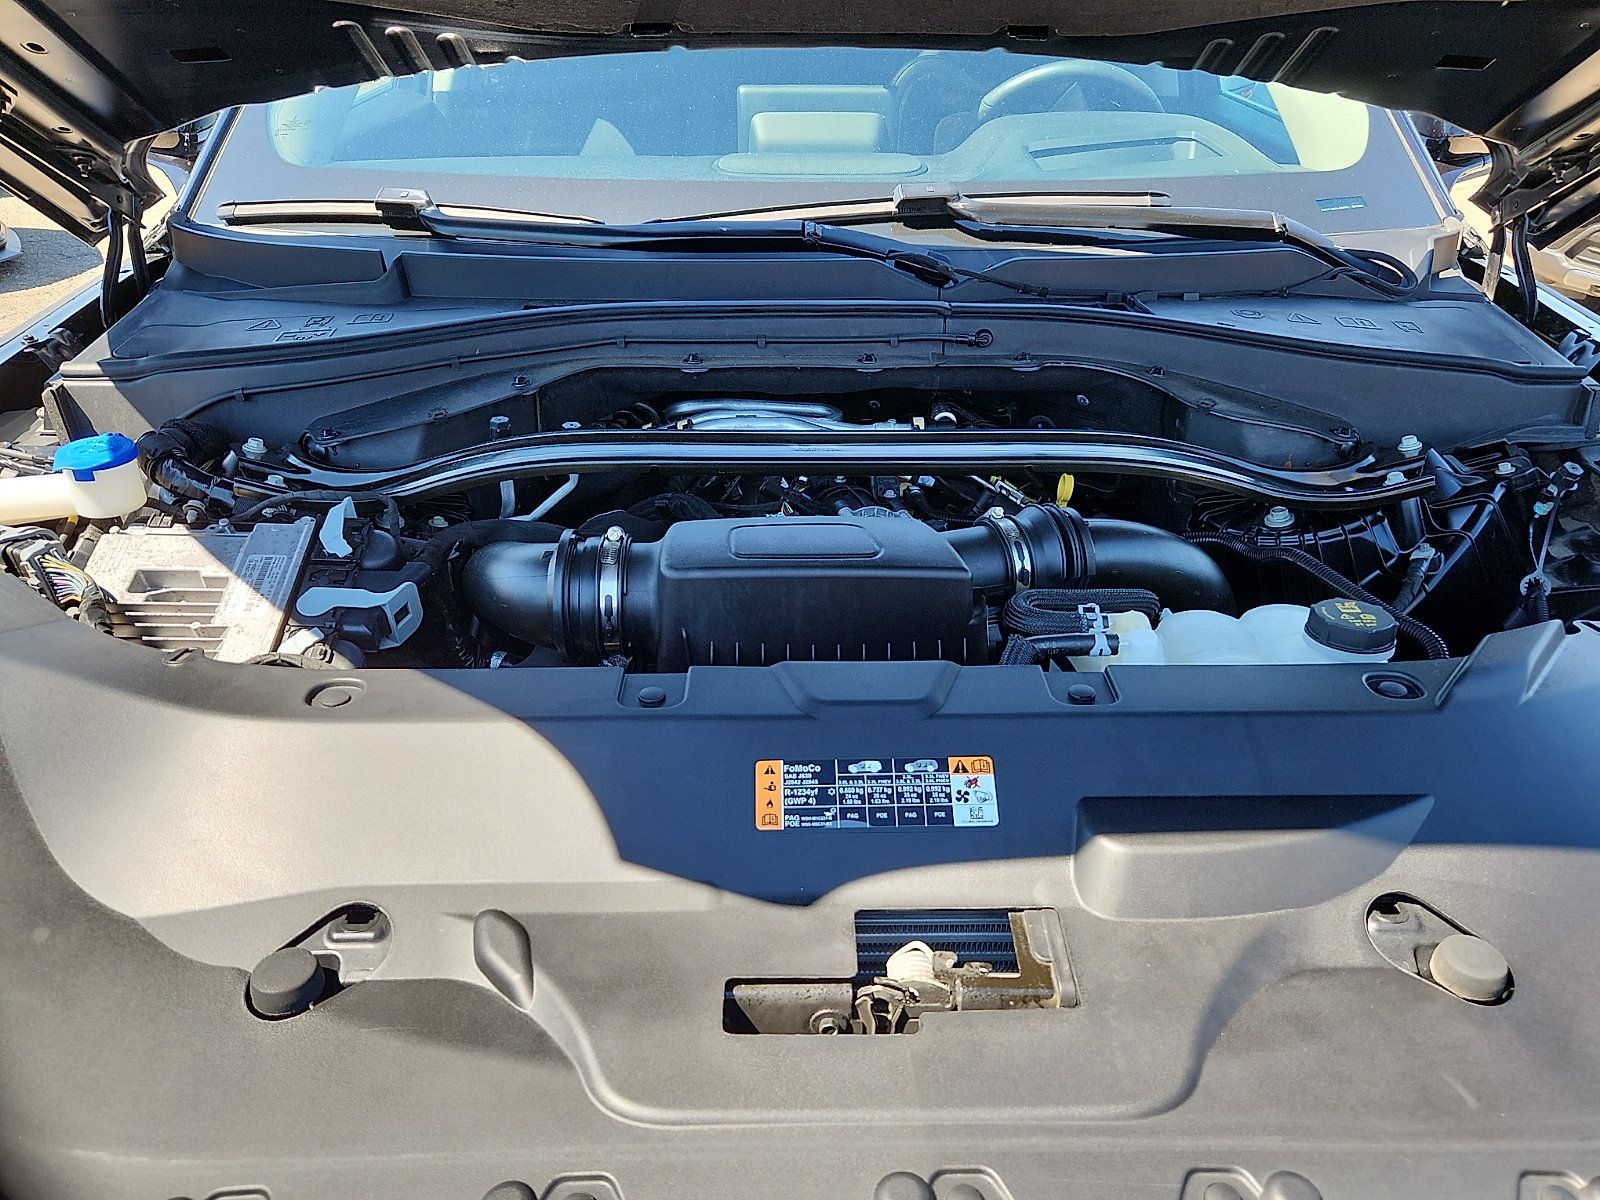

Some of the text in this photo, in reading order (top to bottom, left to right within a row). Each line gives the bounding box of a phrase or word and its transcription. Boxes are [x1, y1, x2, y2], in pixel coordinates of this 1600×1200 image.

[783, 764, 821, 773] FoMoCo
[784, 788, 818, 797] R-1234yf
[856, 787, 864, 795] kg
[808, 797, 816, 805] 4)
